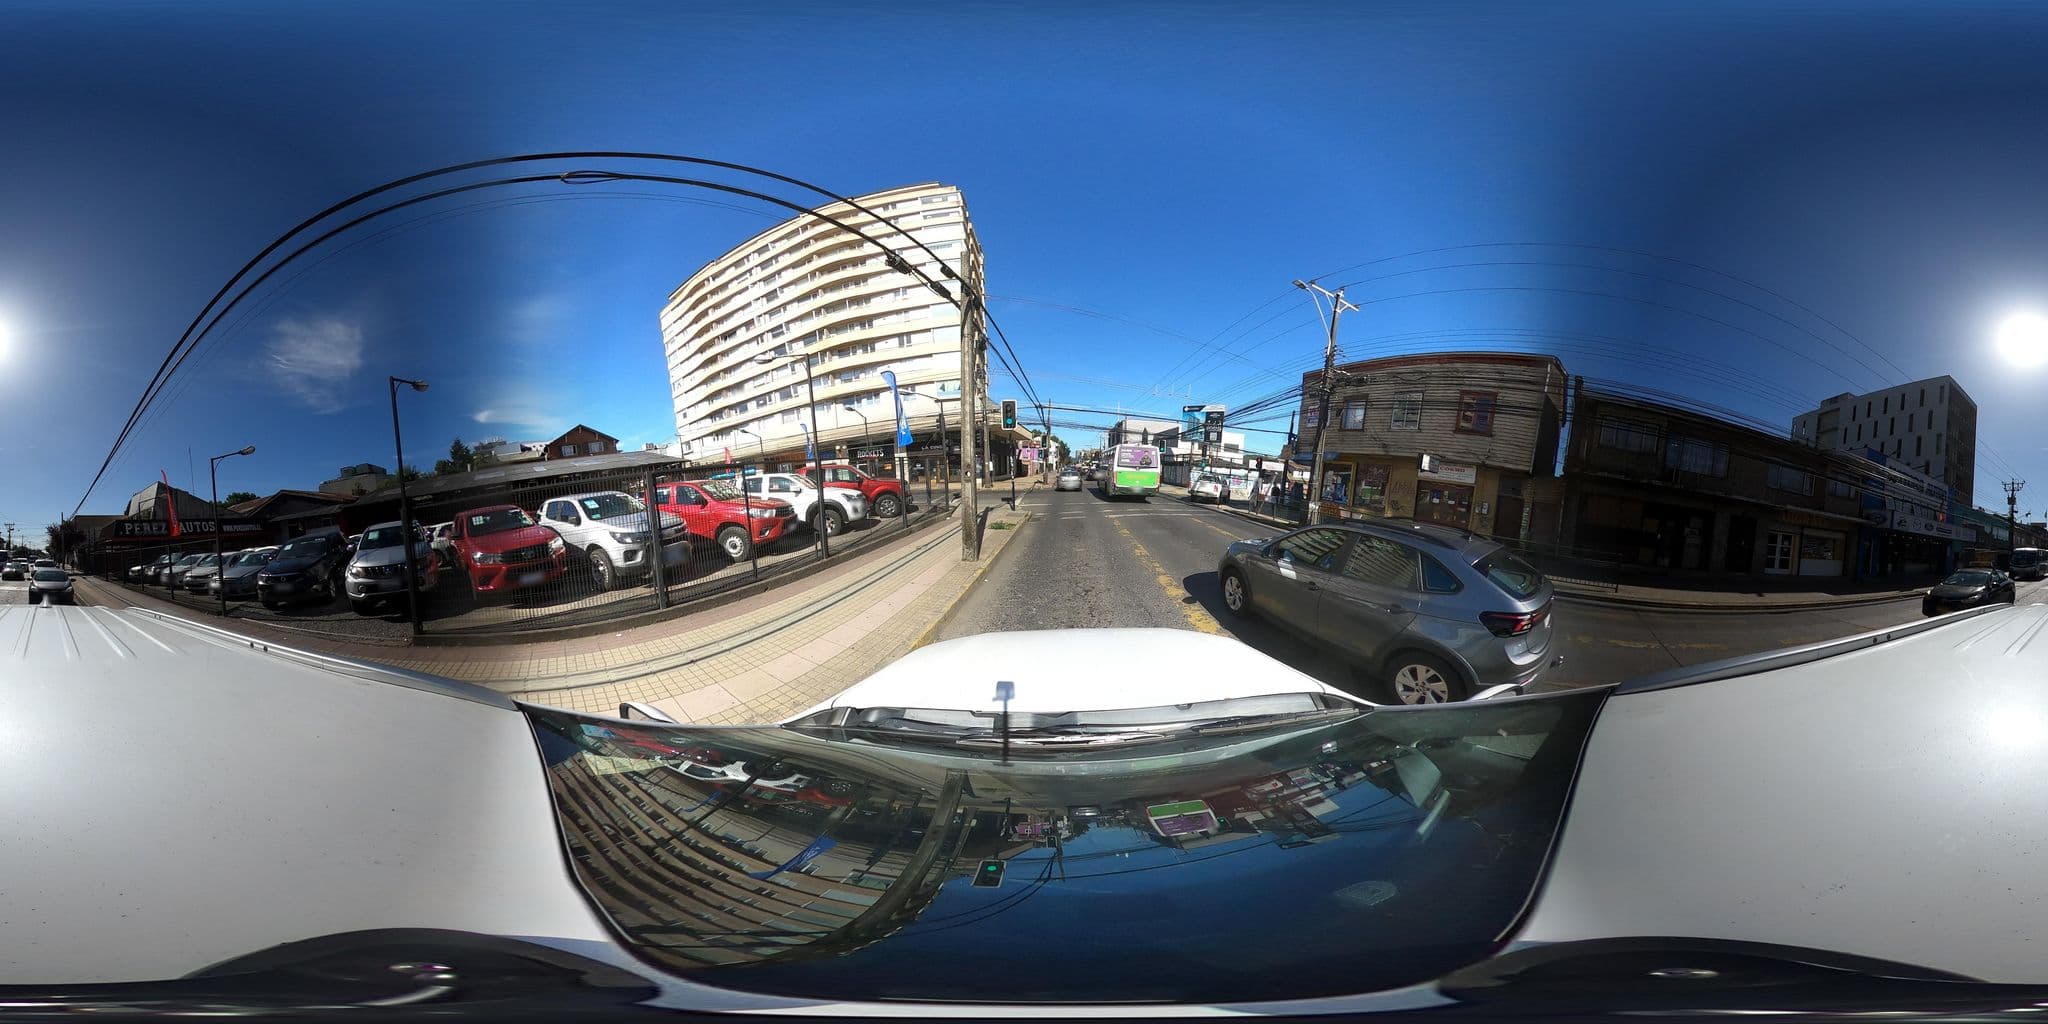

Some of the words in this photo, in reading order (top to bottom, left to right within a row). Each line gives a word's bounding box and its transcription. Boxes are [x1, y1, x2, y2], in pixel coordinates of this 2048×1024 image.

[857, 448, 884, 458] ROCKETS
[125, 522, 167, 535] PEREZ
[179, 521, 216, 534] AUTOS
